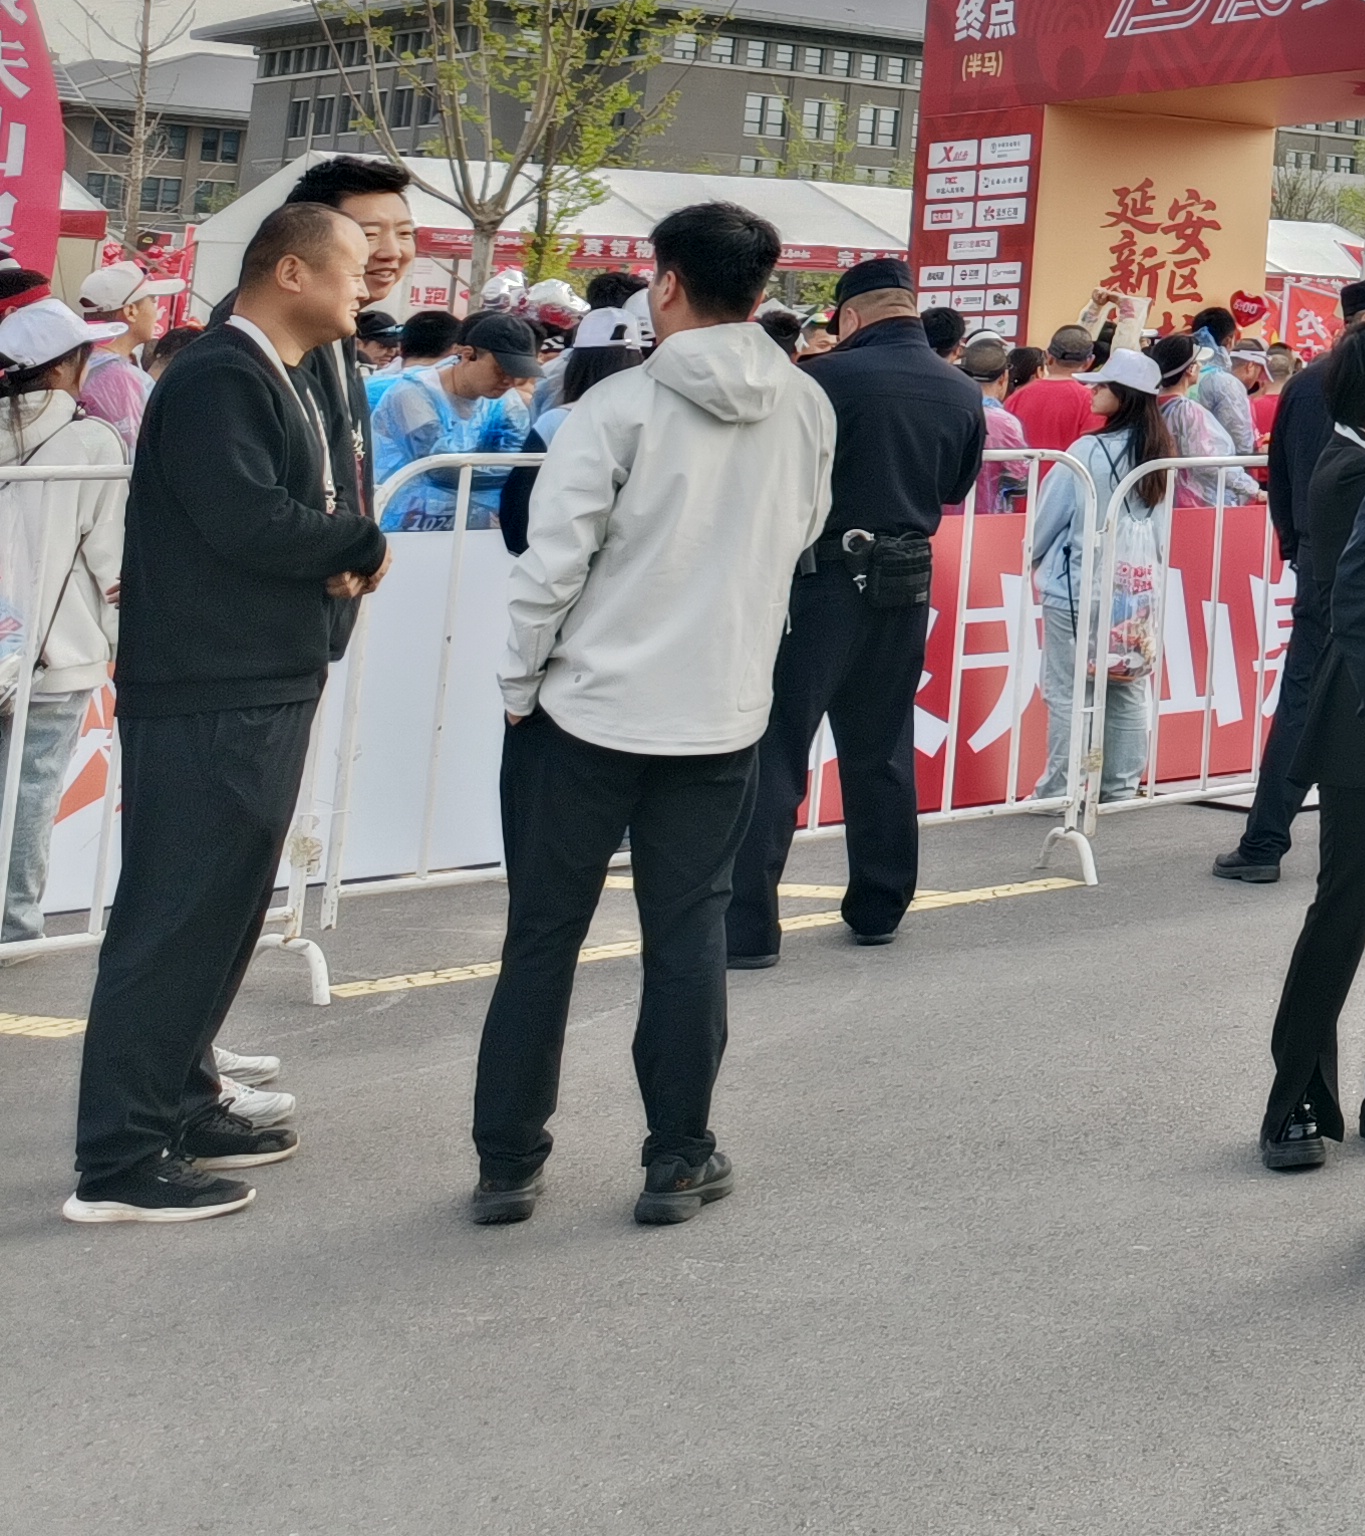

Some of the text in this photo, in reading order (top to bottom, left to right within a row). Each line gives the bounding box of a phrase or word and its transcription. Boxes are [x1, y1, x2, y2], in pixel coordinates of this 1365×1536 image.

[962, 50, 1003, 82] (半马)
[1100, 177, 1223, 262] 延安
[1100, 230, 1204, 307] 新区
